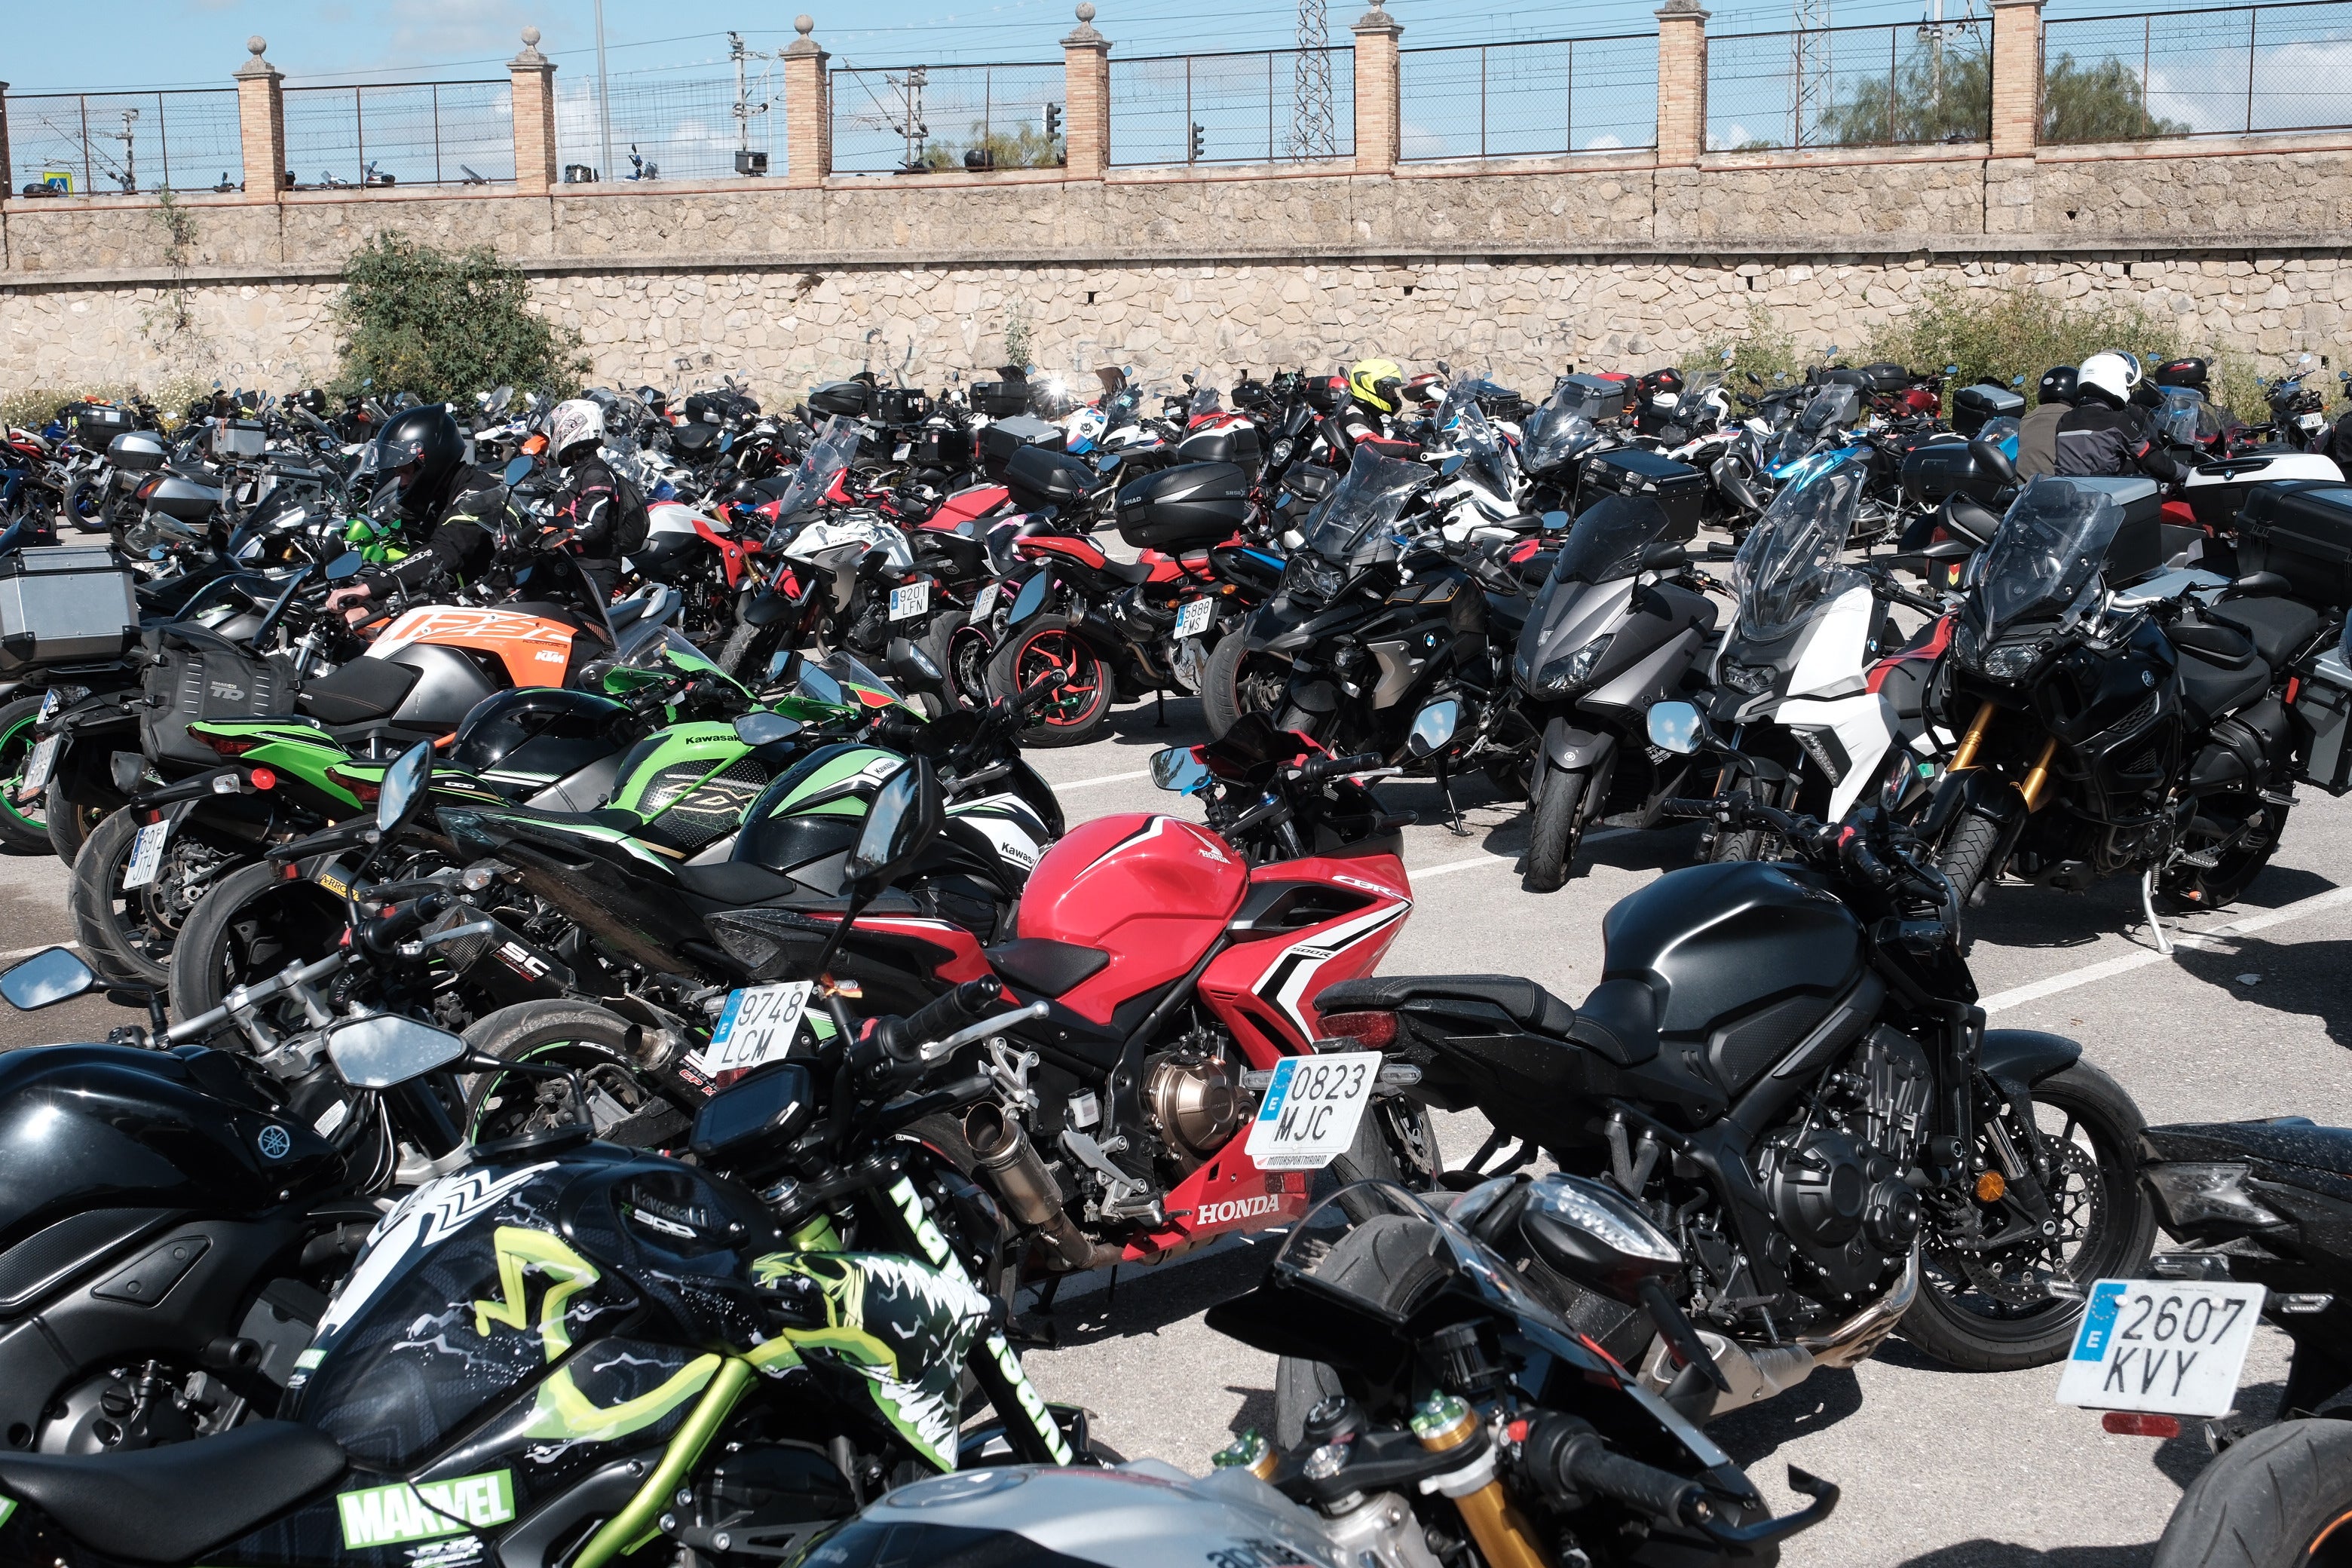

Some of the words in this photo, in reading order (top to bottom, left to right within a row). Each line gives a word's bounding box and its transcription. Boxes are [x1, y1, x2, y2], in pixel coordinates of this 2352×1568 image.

[1123, 496, 1142, 506] SHAD
[899, 584, 926, 602] 9201
[902, 599, 923, 616] LFN
[1184, 601, 1210, 619] 5888
[1181, 617, 1202, 634] FMS
[534, 649, 565, 663] KTM
[685, 734, 743, 746] Kawasak
[1001, 841, 1035, 865] Kawas
[1199, 849, 1232, 865] HONDA
[1332, 875, 1392, 896] CBR
[497, 941, 551, 977] SC
[1290, 947, 1332, 958] 500R
[737, 990, 804, 1027] 9748
[720, 1023, 728, 1034] E
[721, 1027, 775, 1064] LCM
[678, 1069, 703, 1086] GP
[1291, 1064, 1367, 1101] 0823
[1268, 1097, 1279, 1111] E
[1273, 1104, 1334, 1141] MJC
[1266, 1155, 1328, 1166] MOTORSPORTMADRID
[1197, 1193, 1280, 1226] HONDA
[2121, 1294, 2247, 1345] 2607
[2086, 1330, 2102, 1348] E
[2102, 1346, 2200, 1397] KVY
[342, 1475, 512, 1546] MARVEL
